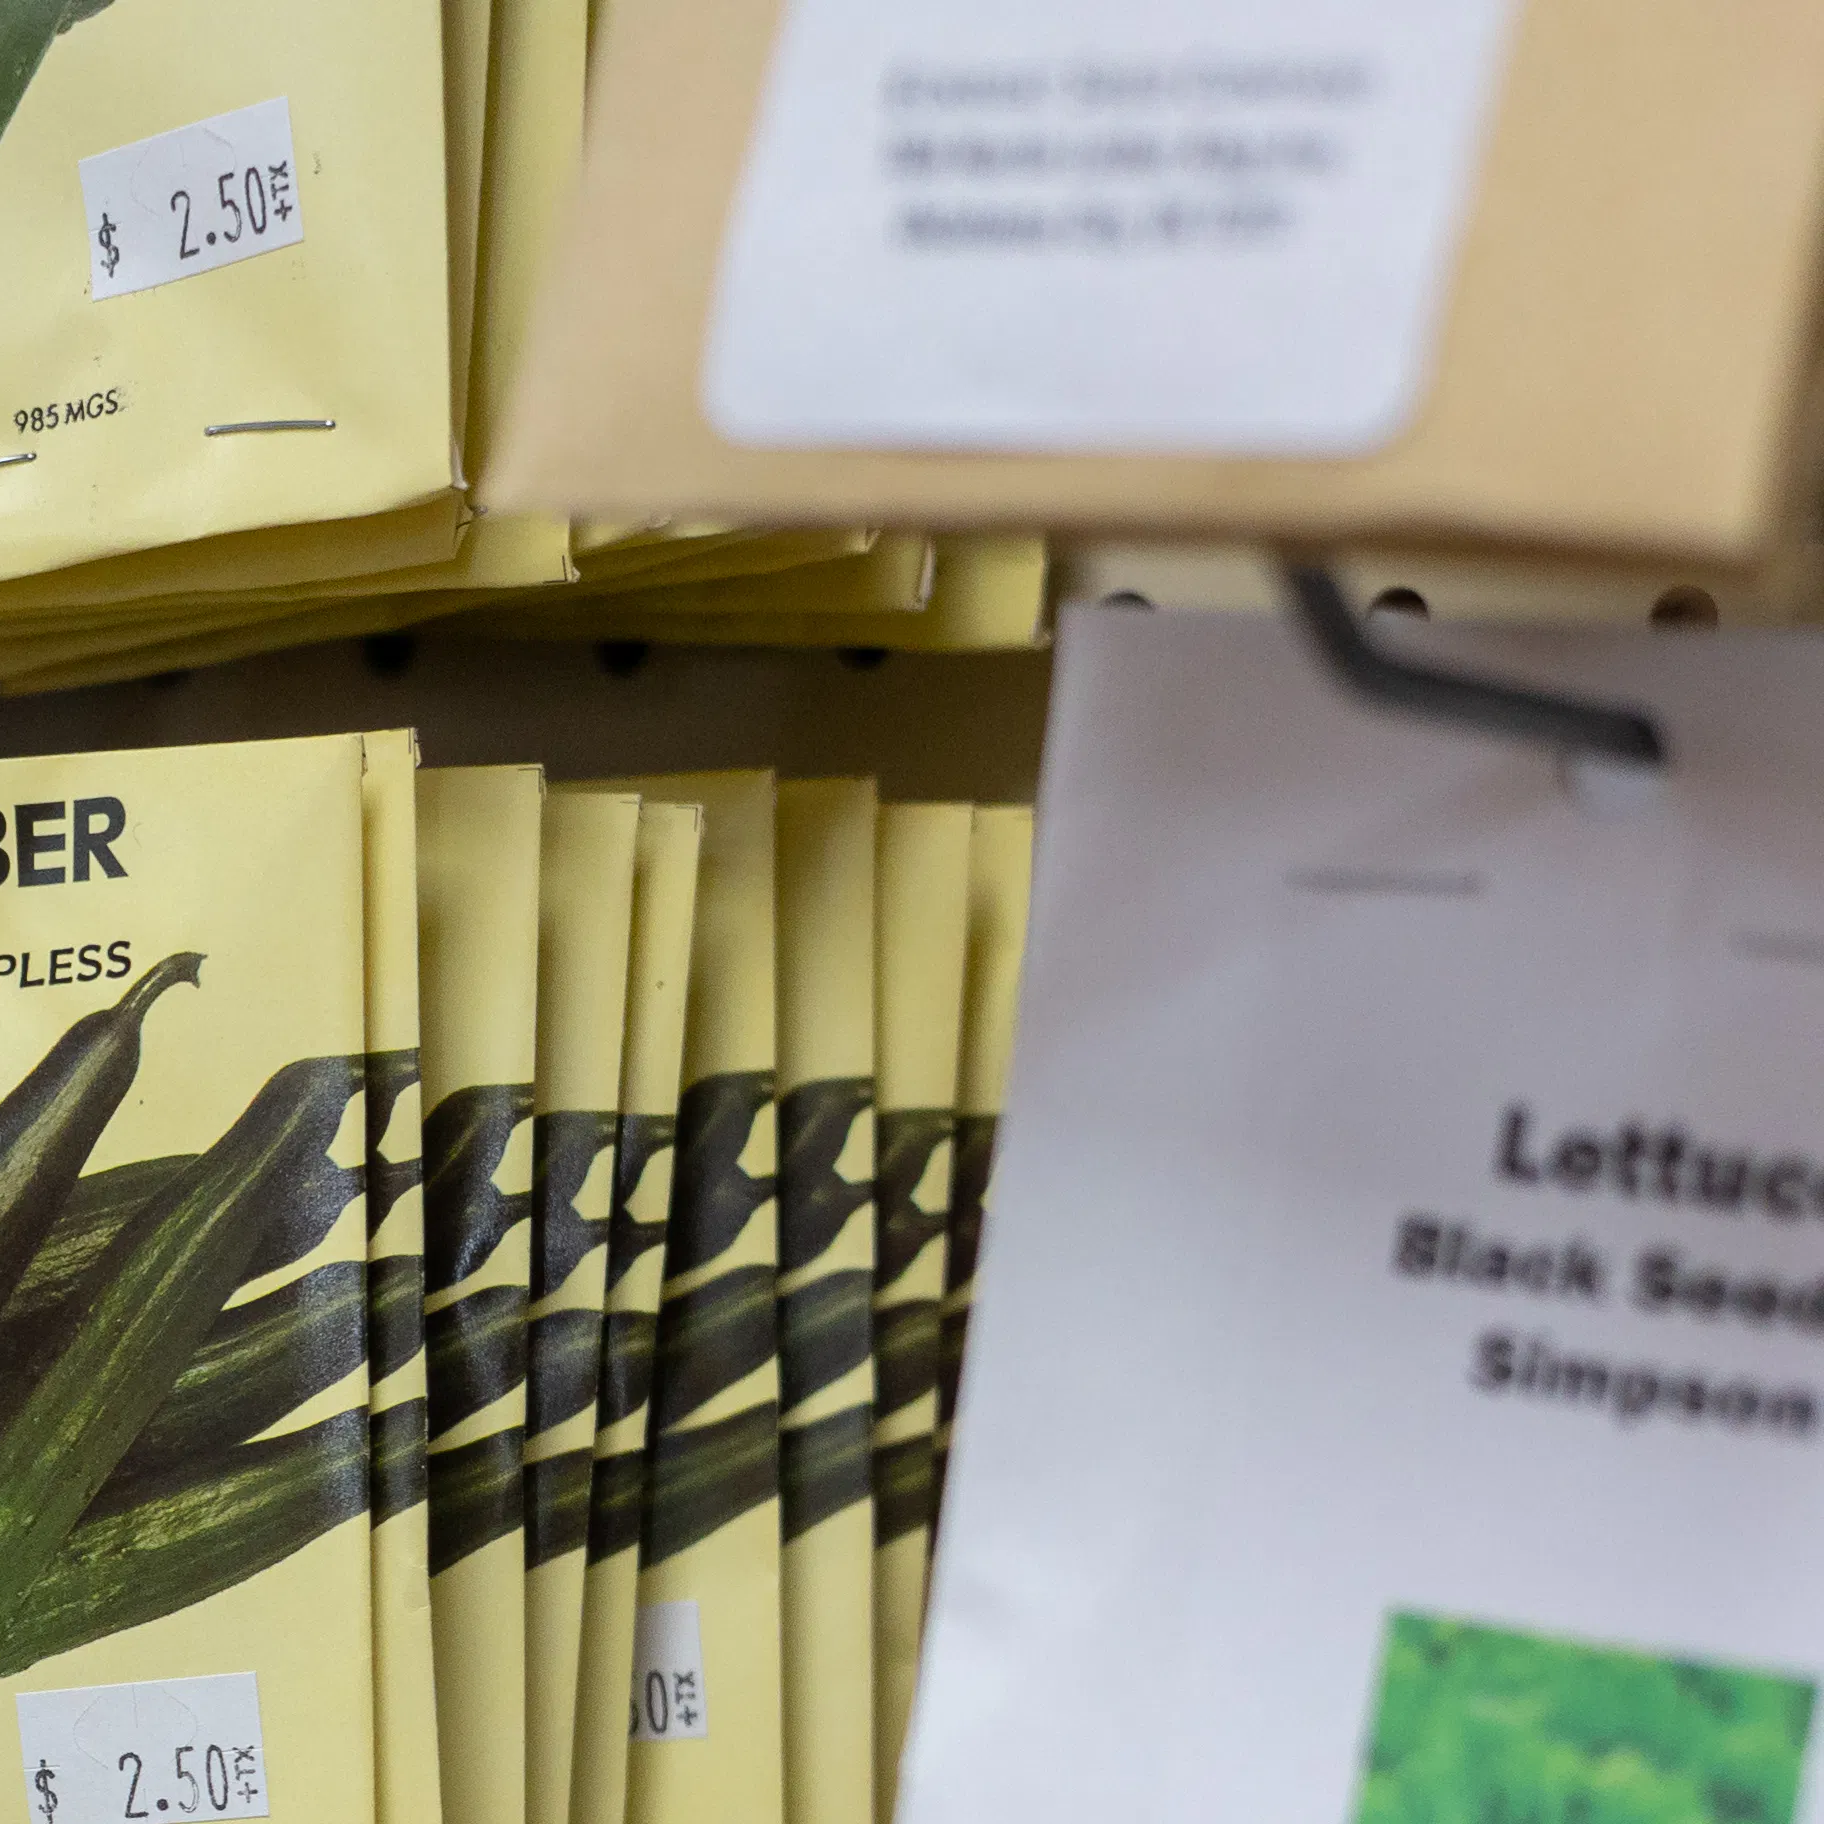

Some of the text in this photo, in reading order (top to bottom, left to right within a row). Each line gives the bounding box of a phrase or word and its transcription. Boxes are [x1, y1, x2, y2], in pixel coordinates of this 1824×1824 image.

[97, 212, 121, 278] $
[169, 166, 269, 260] 2.50
[13, 405, 60, 435] 985
[118, 1744, 229, 1820] 2.50
